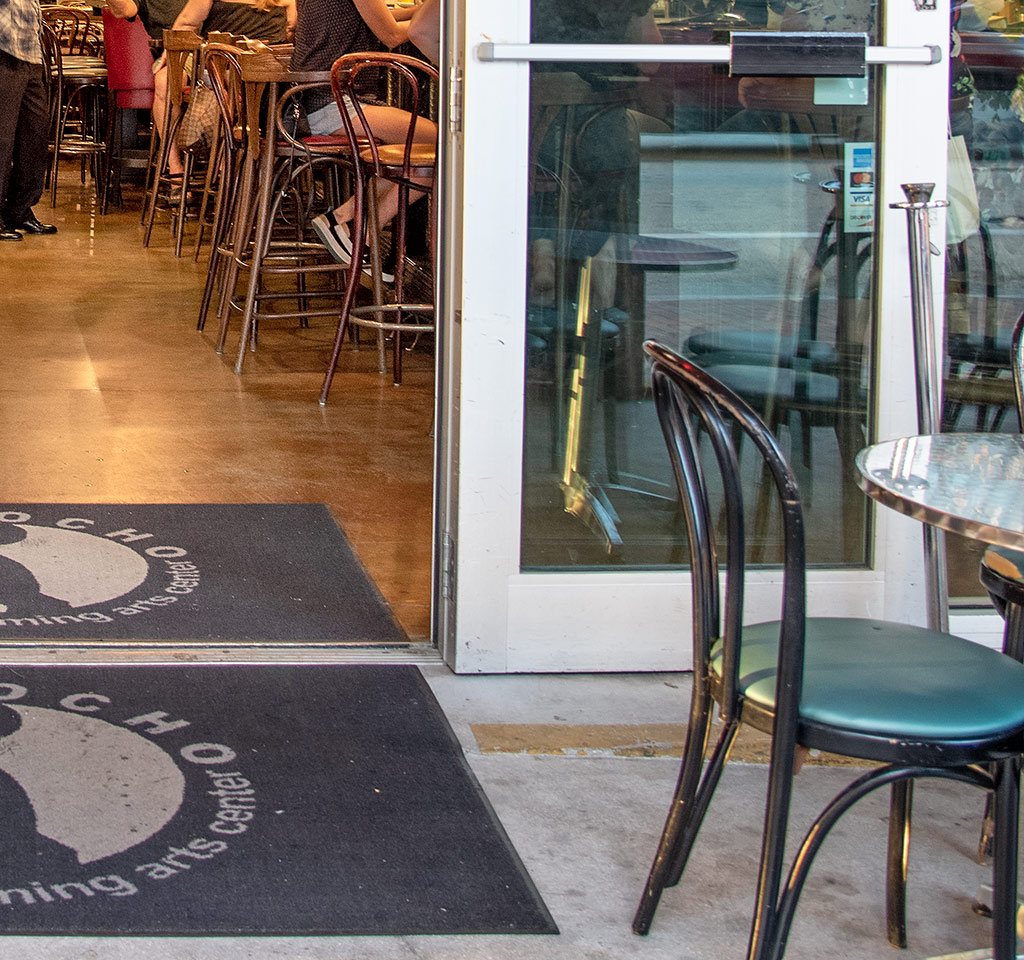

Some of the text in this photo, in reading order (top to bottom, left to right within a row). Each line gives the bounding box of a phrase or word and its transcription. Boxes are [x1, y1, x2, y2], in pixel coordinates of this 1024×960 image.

[853, 195, 871, 203] VISA
[111, 593, 178, 617] arts
[164, 559, 201, 595] center
[135, 834, 229, 881] arts
[207, 768, 257, 837] center
